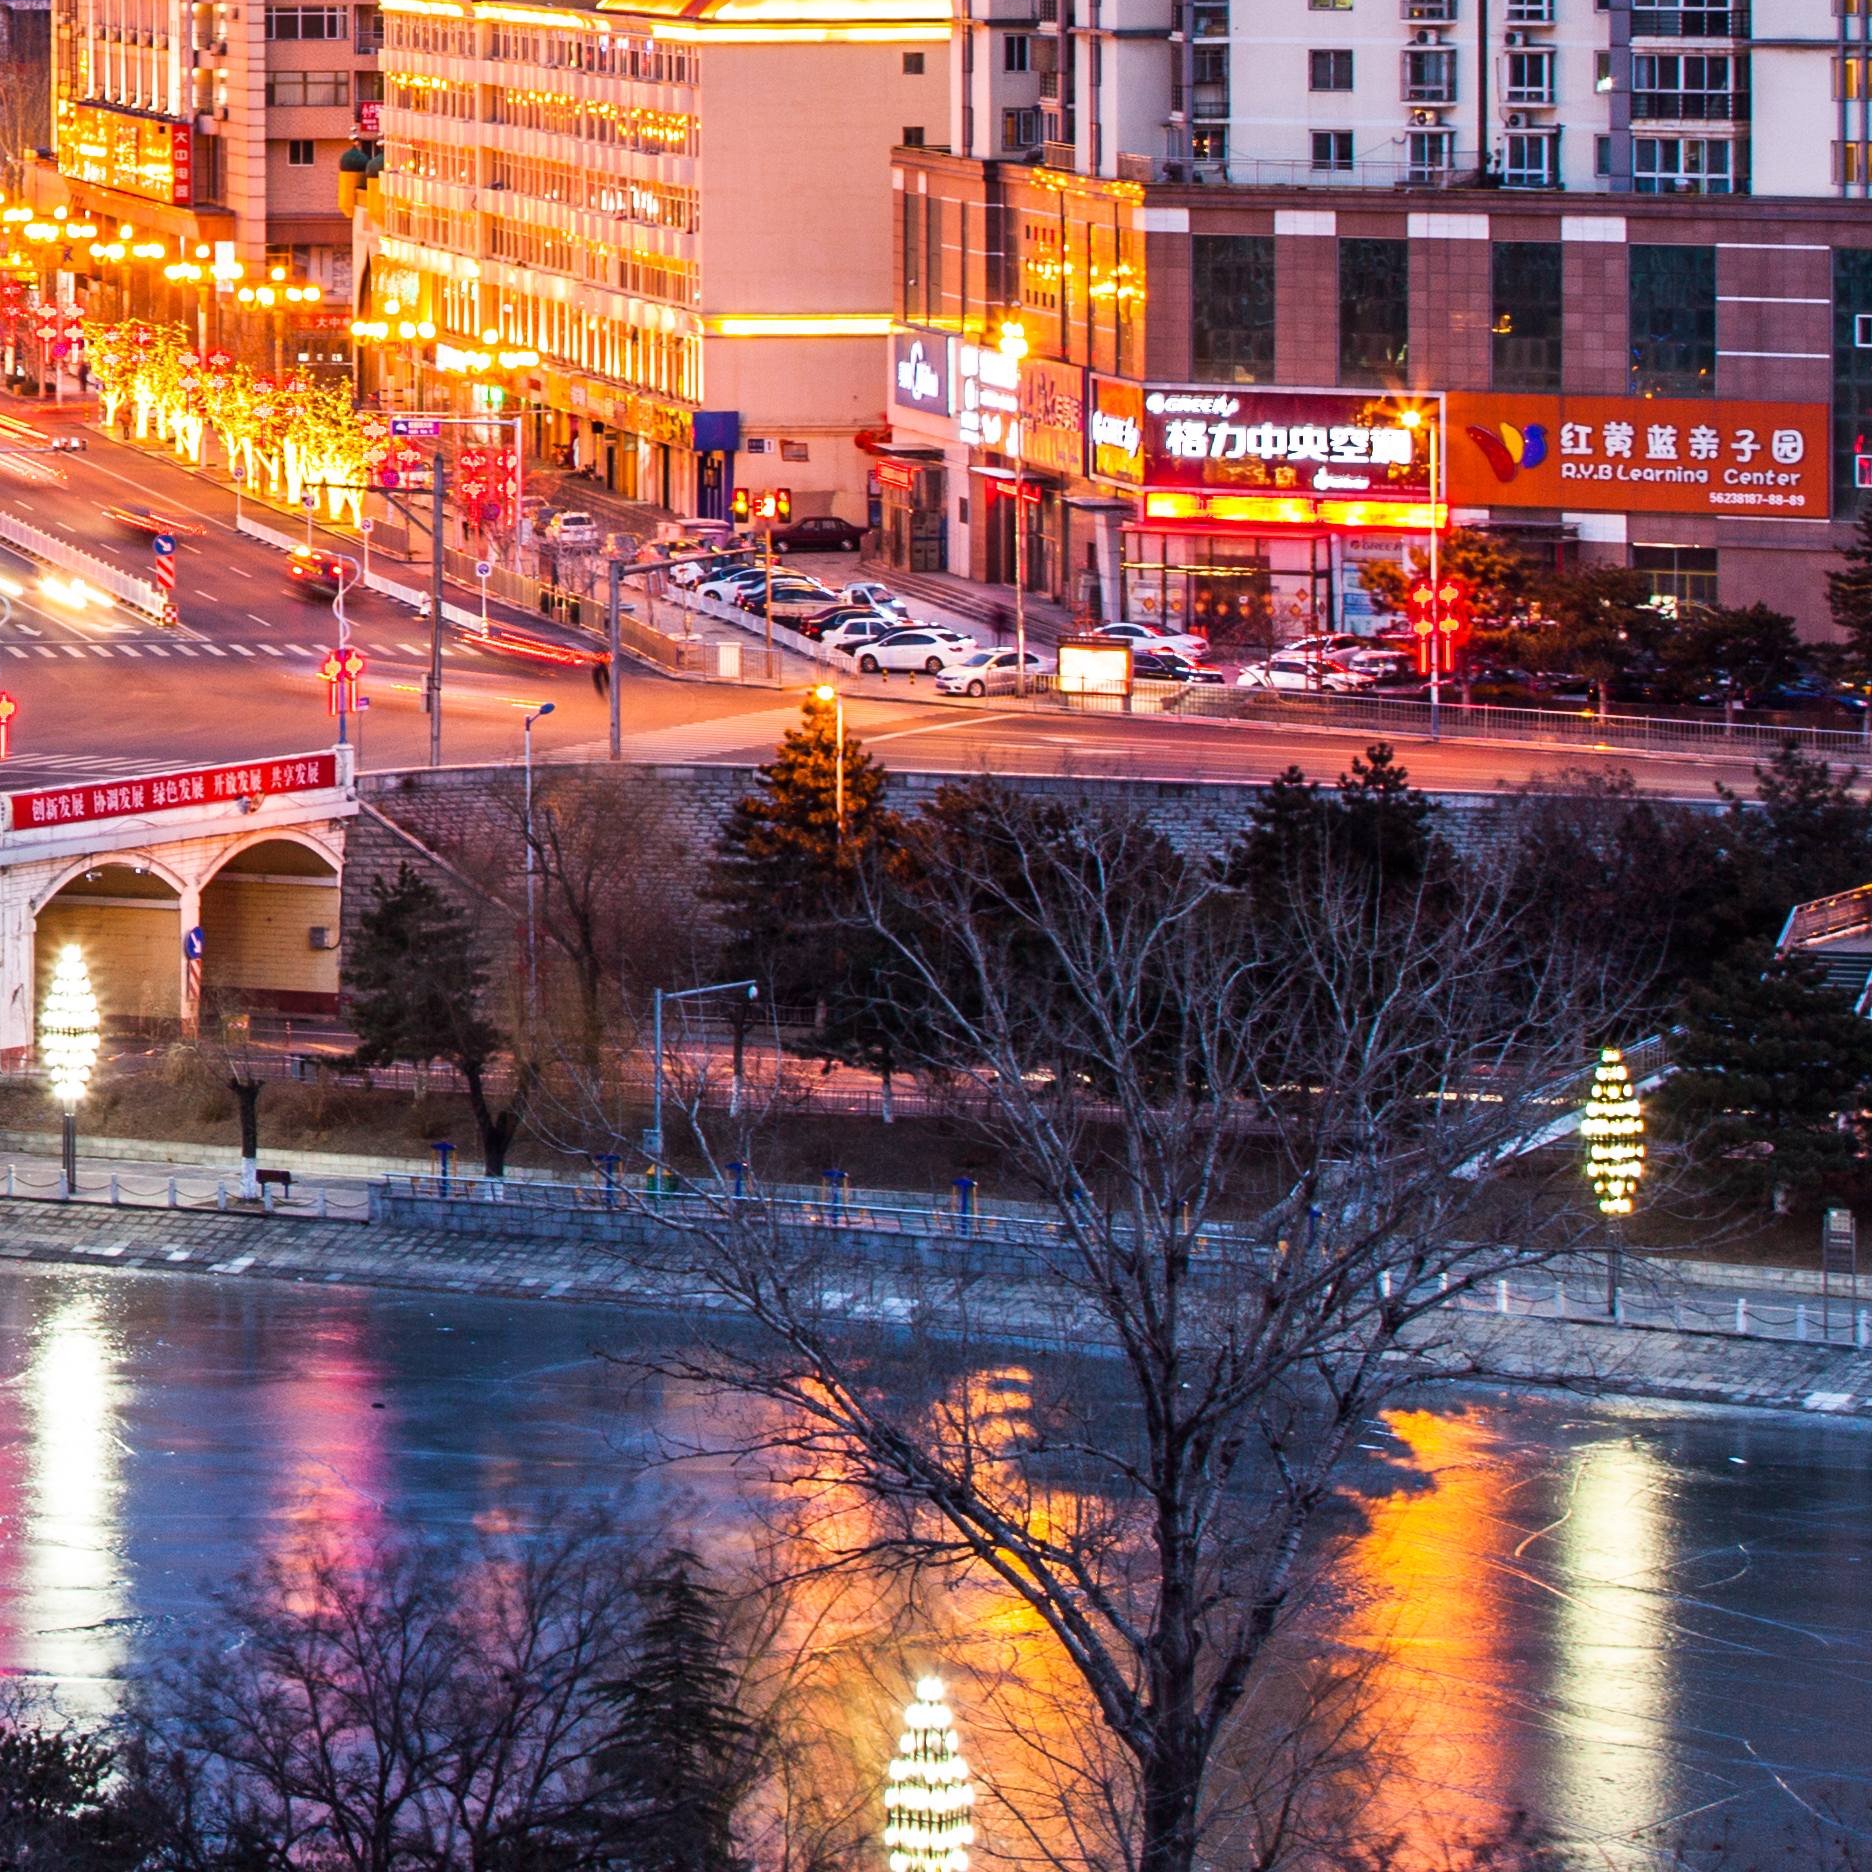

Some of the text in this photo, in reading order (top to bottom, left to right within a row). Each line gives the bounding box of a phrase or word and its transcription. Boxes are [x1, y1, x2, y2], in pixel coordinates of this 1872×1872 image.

[174, 131, 189, 198] 大中电器
[1165, 419, 1413, 464] 格力中央空调
[1560, 421, 1804, 464] 红黄蓝亲子园
[1561, 463, 1802, 486] R.Y.B Learning Center
[1709, 492, 1805, 507] 56238187-88-89
[31, 761, 320, 822] 创新发展 协调发展 绿色发展 开放发展 共享发展
